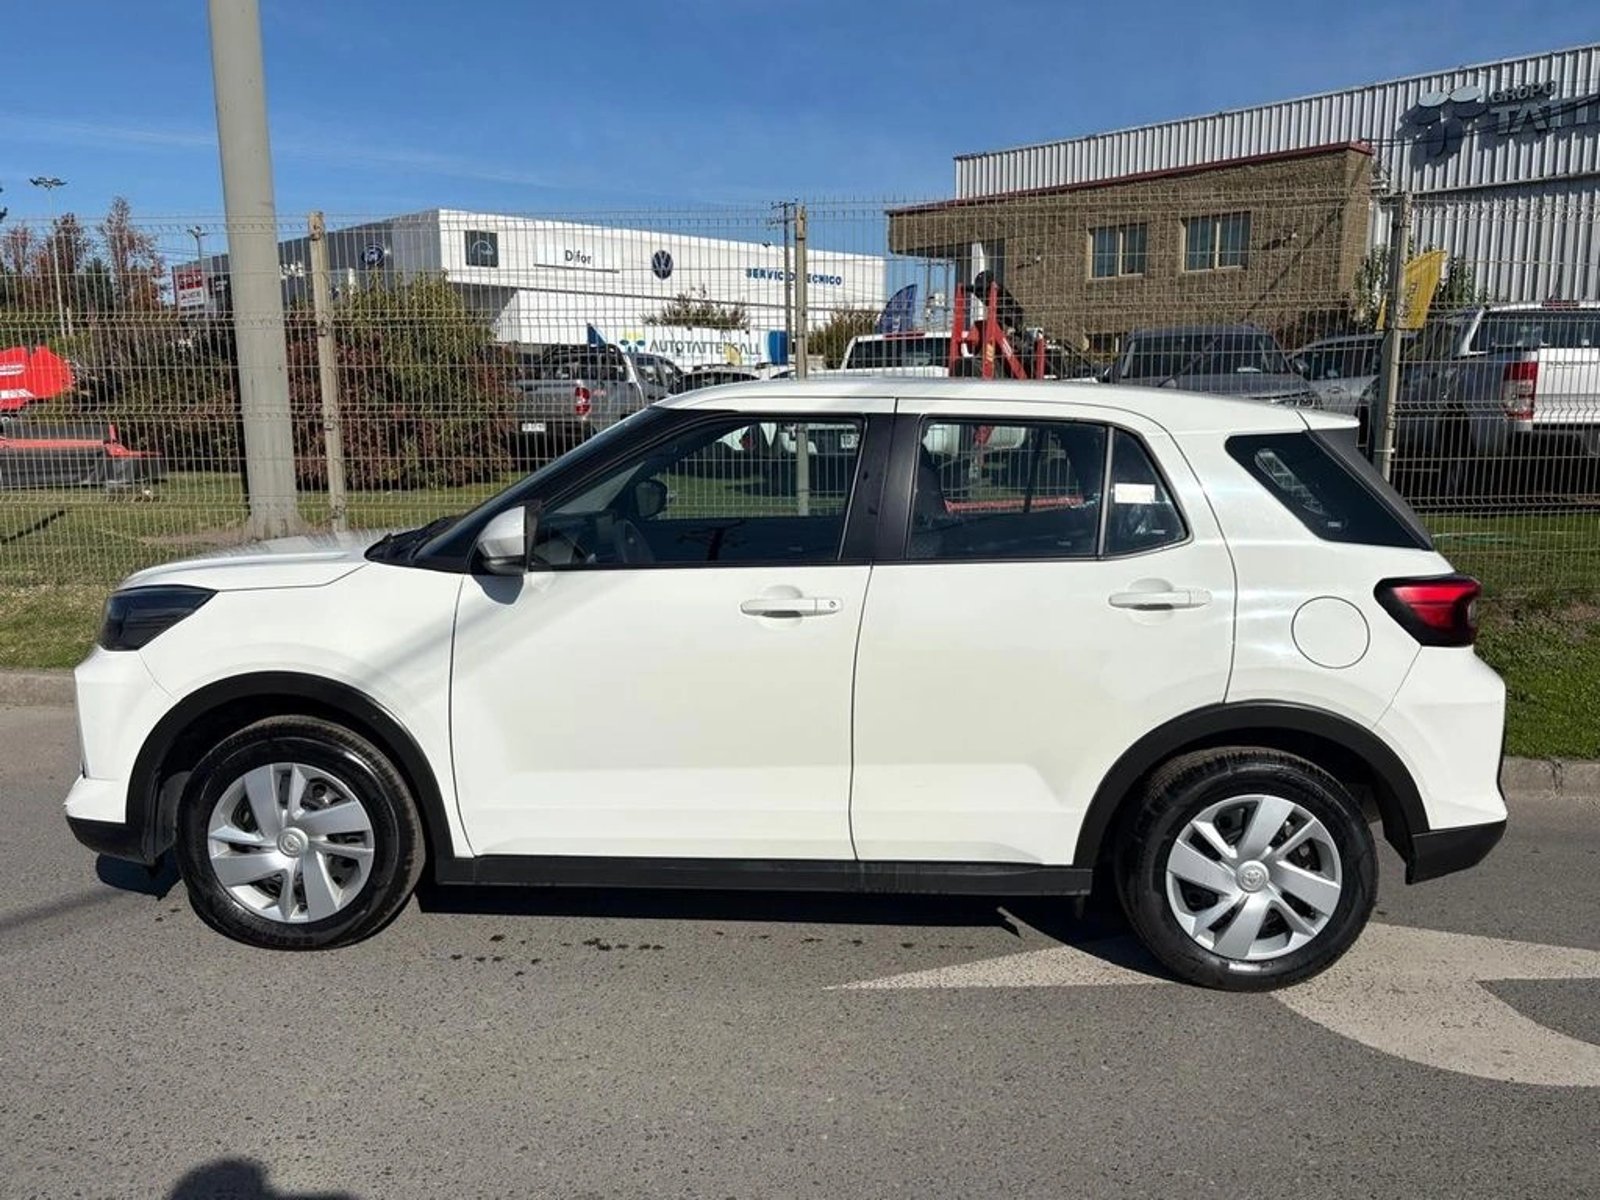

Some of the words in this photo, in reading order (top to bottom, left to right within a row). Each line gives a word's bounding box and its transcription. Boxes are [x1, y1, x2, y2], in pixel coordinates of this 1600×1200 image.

[1491, 80, 1556, 102] GRUPO
[565, 249, 592, 264] Dfor
[746, 268, 798, 281] SERVICO
[804, 273, 842, 286] ECNICO
